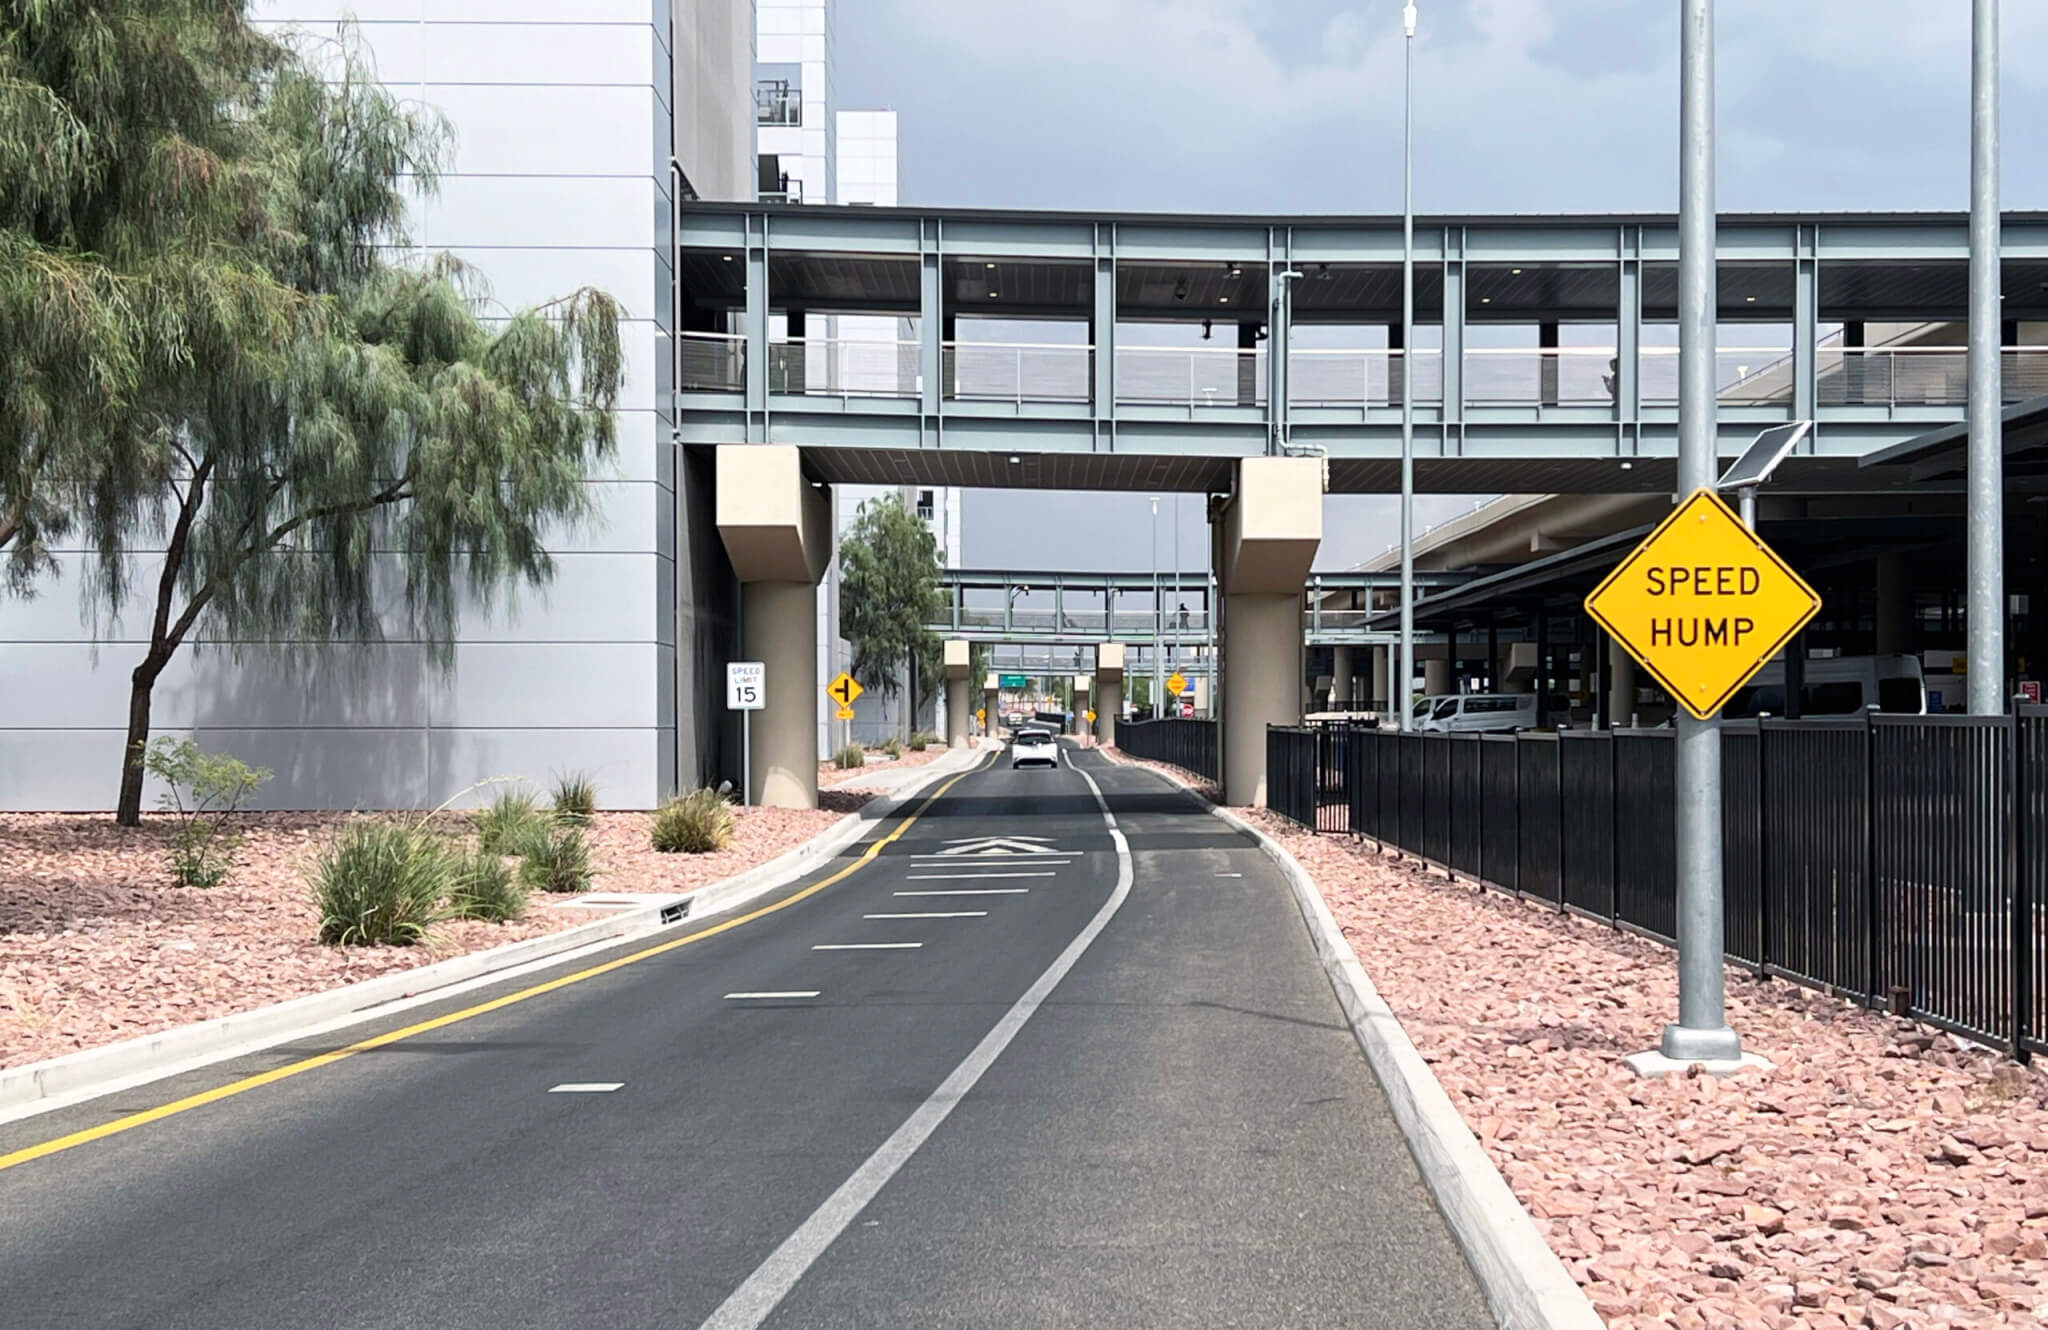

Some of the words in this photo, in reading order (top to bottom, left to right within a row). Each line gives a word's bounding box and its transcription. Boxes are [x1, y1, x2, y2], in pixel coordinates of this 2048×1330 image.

[1646, 566, 1760, 596] SPEED
[1651, 617, 1754, 647] HUMP
[732, 667, 760, 675] SPEED
[736, 686, 756, 703] 15
